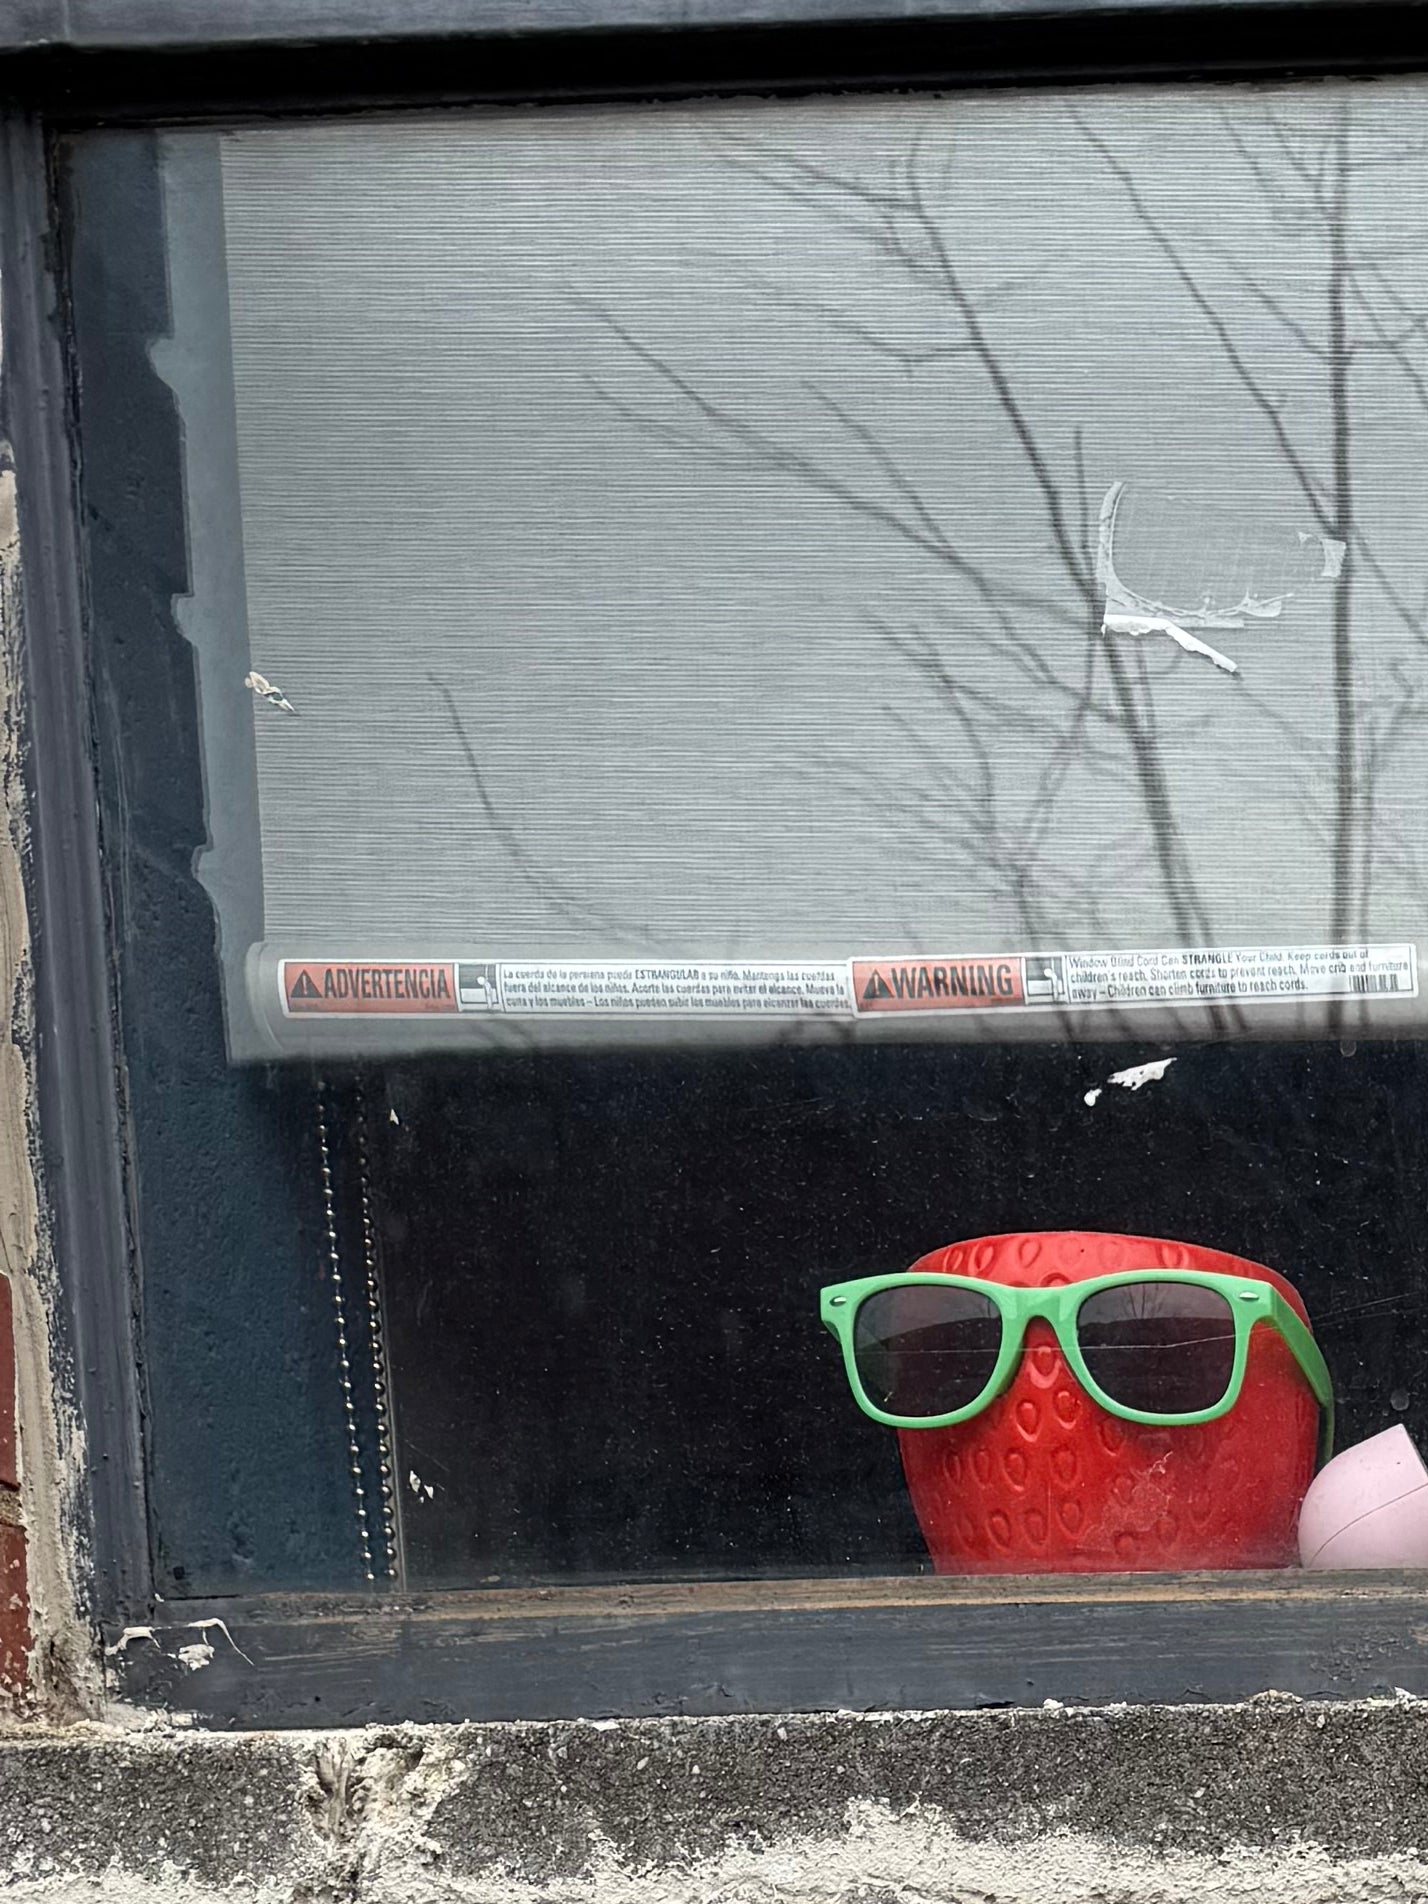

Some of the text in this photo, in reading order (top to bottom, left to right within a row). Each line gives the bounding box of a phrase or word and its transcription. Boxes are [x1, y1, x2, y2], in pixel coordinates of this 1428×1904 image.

[1182, 954, 1232, 965] STRANGLE
[1235, 952, 1256, 962] Your
[1288, 951, 1311, 962] Keep
[1314, 950, 1340, 960] cords
[1342, 949, 1357, 959] out
[1360, 949, 1369, 959] of
[1218, 967, 1227, 978] to
[1329, 962, 1346, 974] crib
[324, 968, 450, 999] ADVERTENCIA
[891, 964, 1014, 1001] WARNING
[1108, 985, 1146, 998] Children
[1149, 985, 1166, 996] can
[1169, 982, 1193, 995] climb
[1196, 981, 1235, 994] furniture
[1239, 980, 1247, 992] to
[1250, 980, 1277, 992] reach
[1280, 978, 1308, 990] cords.
